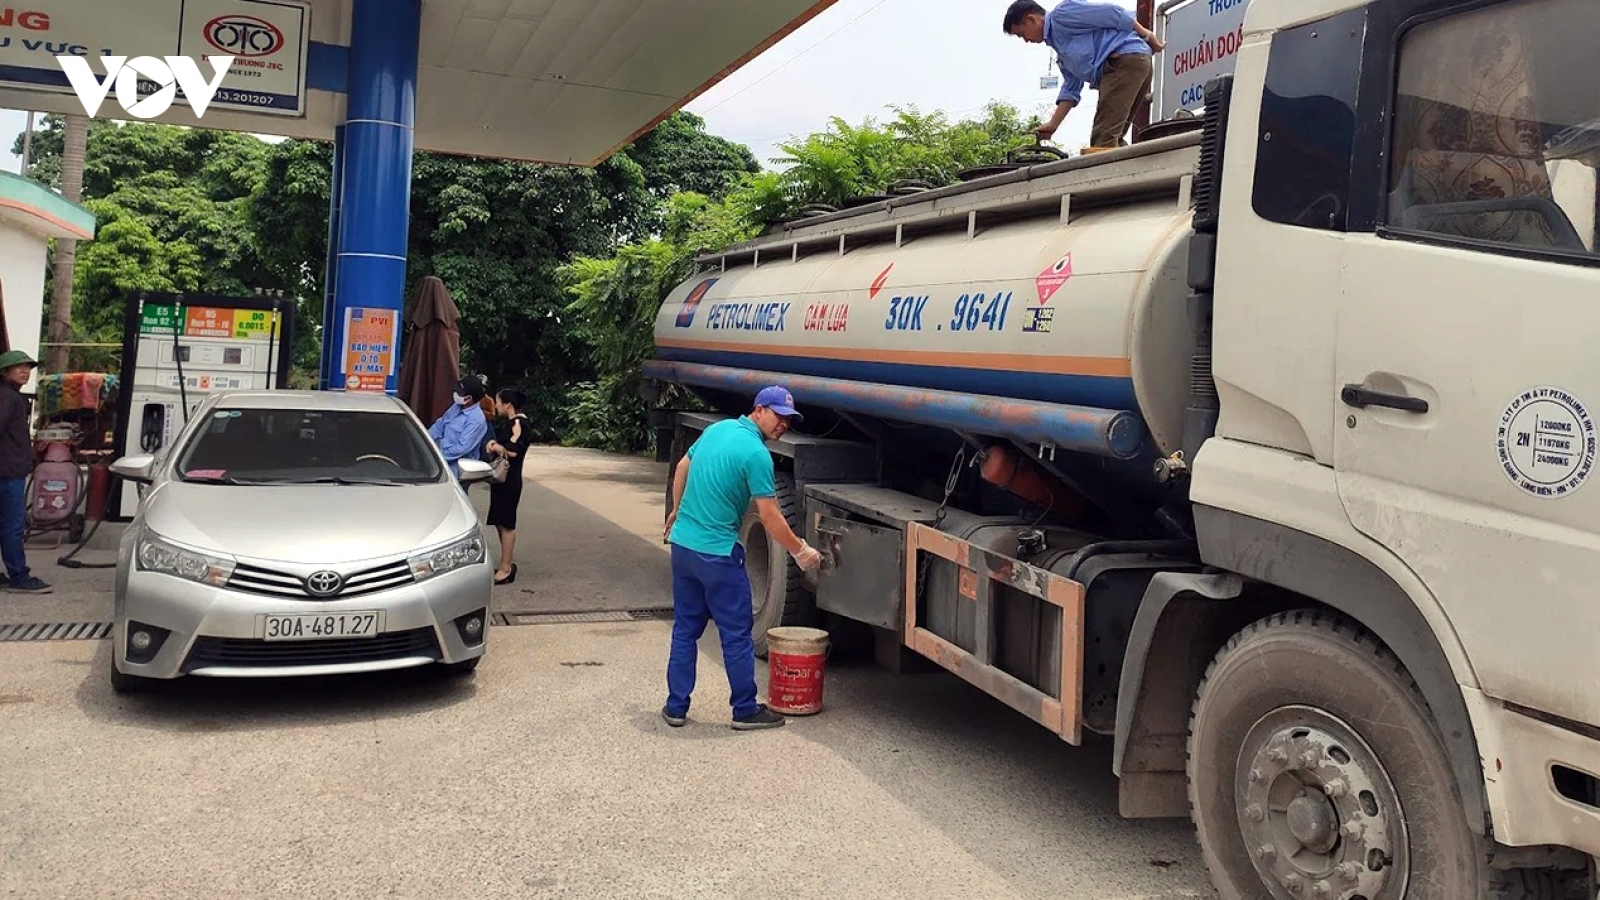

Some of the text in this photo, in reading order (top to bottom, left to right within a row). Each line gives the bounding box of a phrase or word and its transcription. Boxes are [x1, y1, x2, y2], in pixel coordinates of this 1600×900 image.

[1217, 23, 1244, 60] ĐOÁ
[156, 306, 169, 317] E5
[706, 302, 791, 332] PETROLIMEX
[885, 295, 930, 331] 30K
[950, 291, 1013, 332] 9641
[1549, 389, 1588, 420] PETROLIMEX
[267, 614, 375, 638] 30A-481.27
